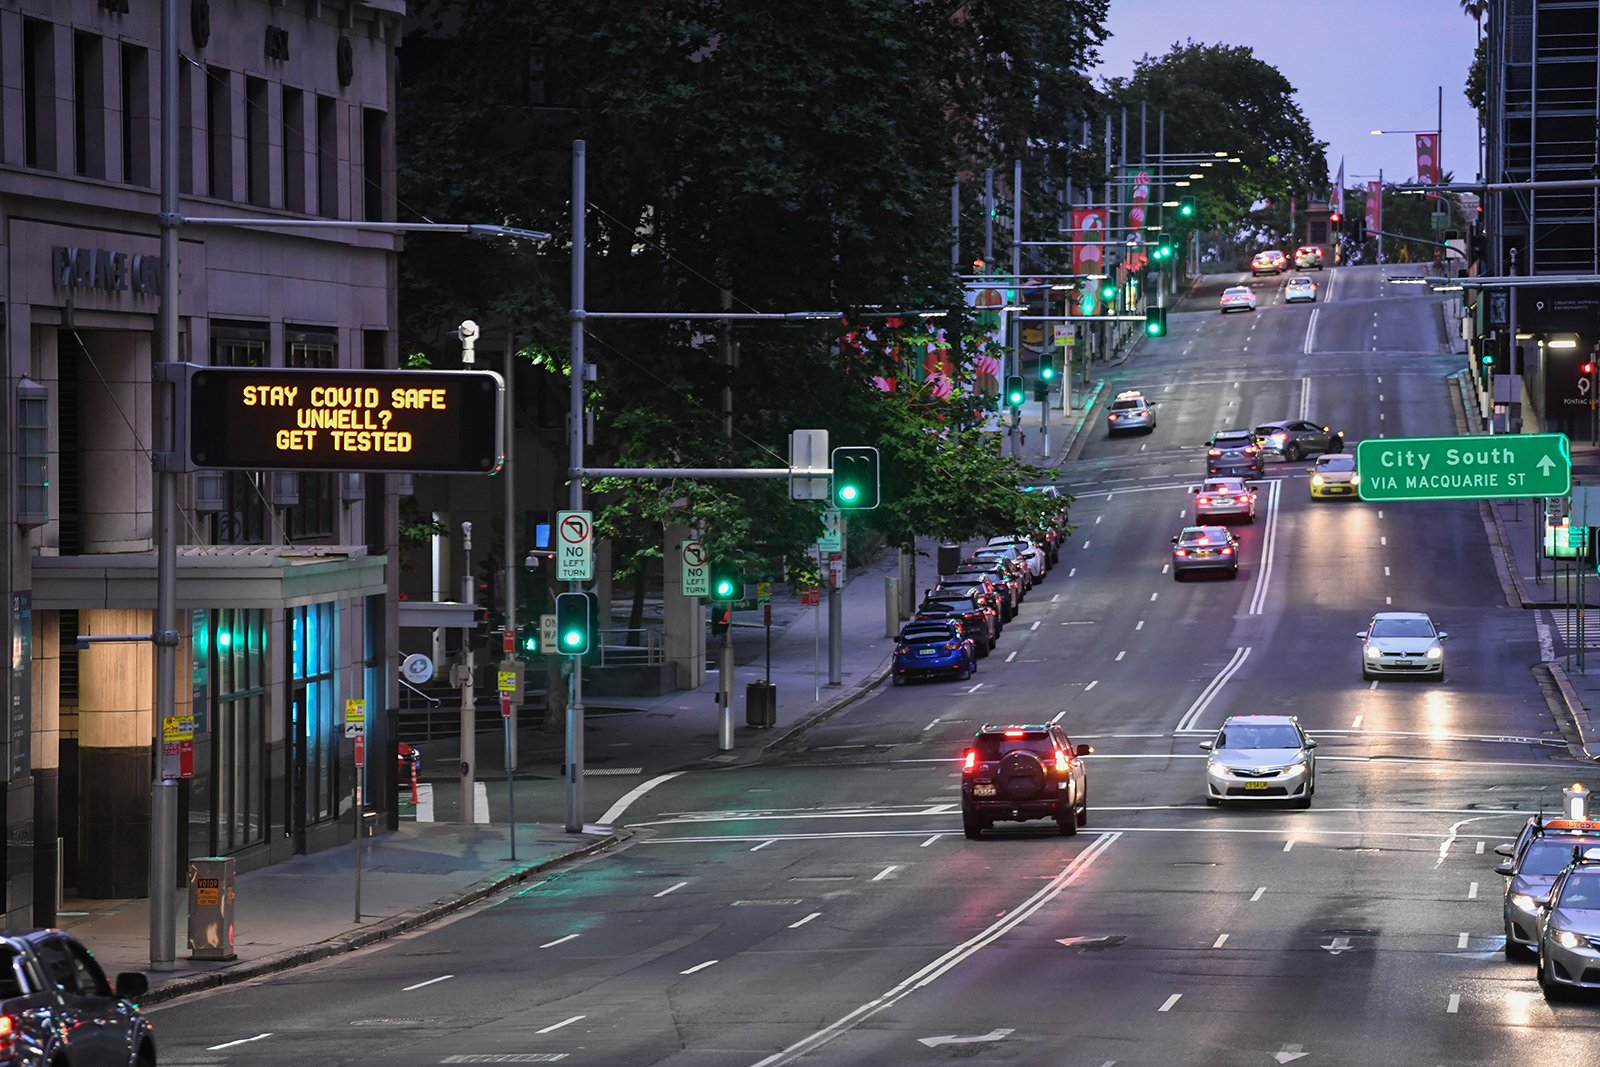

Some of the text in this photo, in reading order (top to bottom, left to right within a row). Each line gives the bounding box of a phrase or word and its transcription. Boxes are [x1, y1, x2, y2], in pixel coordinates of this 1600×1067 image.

[243, 386, 446, 410] STAY COVID SAFE
[297, 408, 392, 430] UNWELL?
[276, 430, 412, 452] GET TESTED
[1381, 448, 1515, 470] City South
[1371, 473, 1526, 490] VIA MACQUARIE ST
[566, 547, 584, 557] NO
[688, 568, 702, 577] NO
[544, 618, 556, 628] ON
